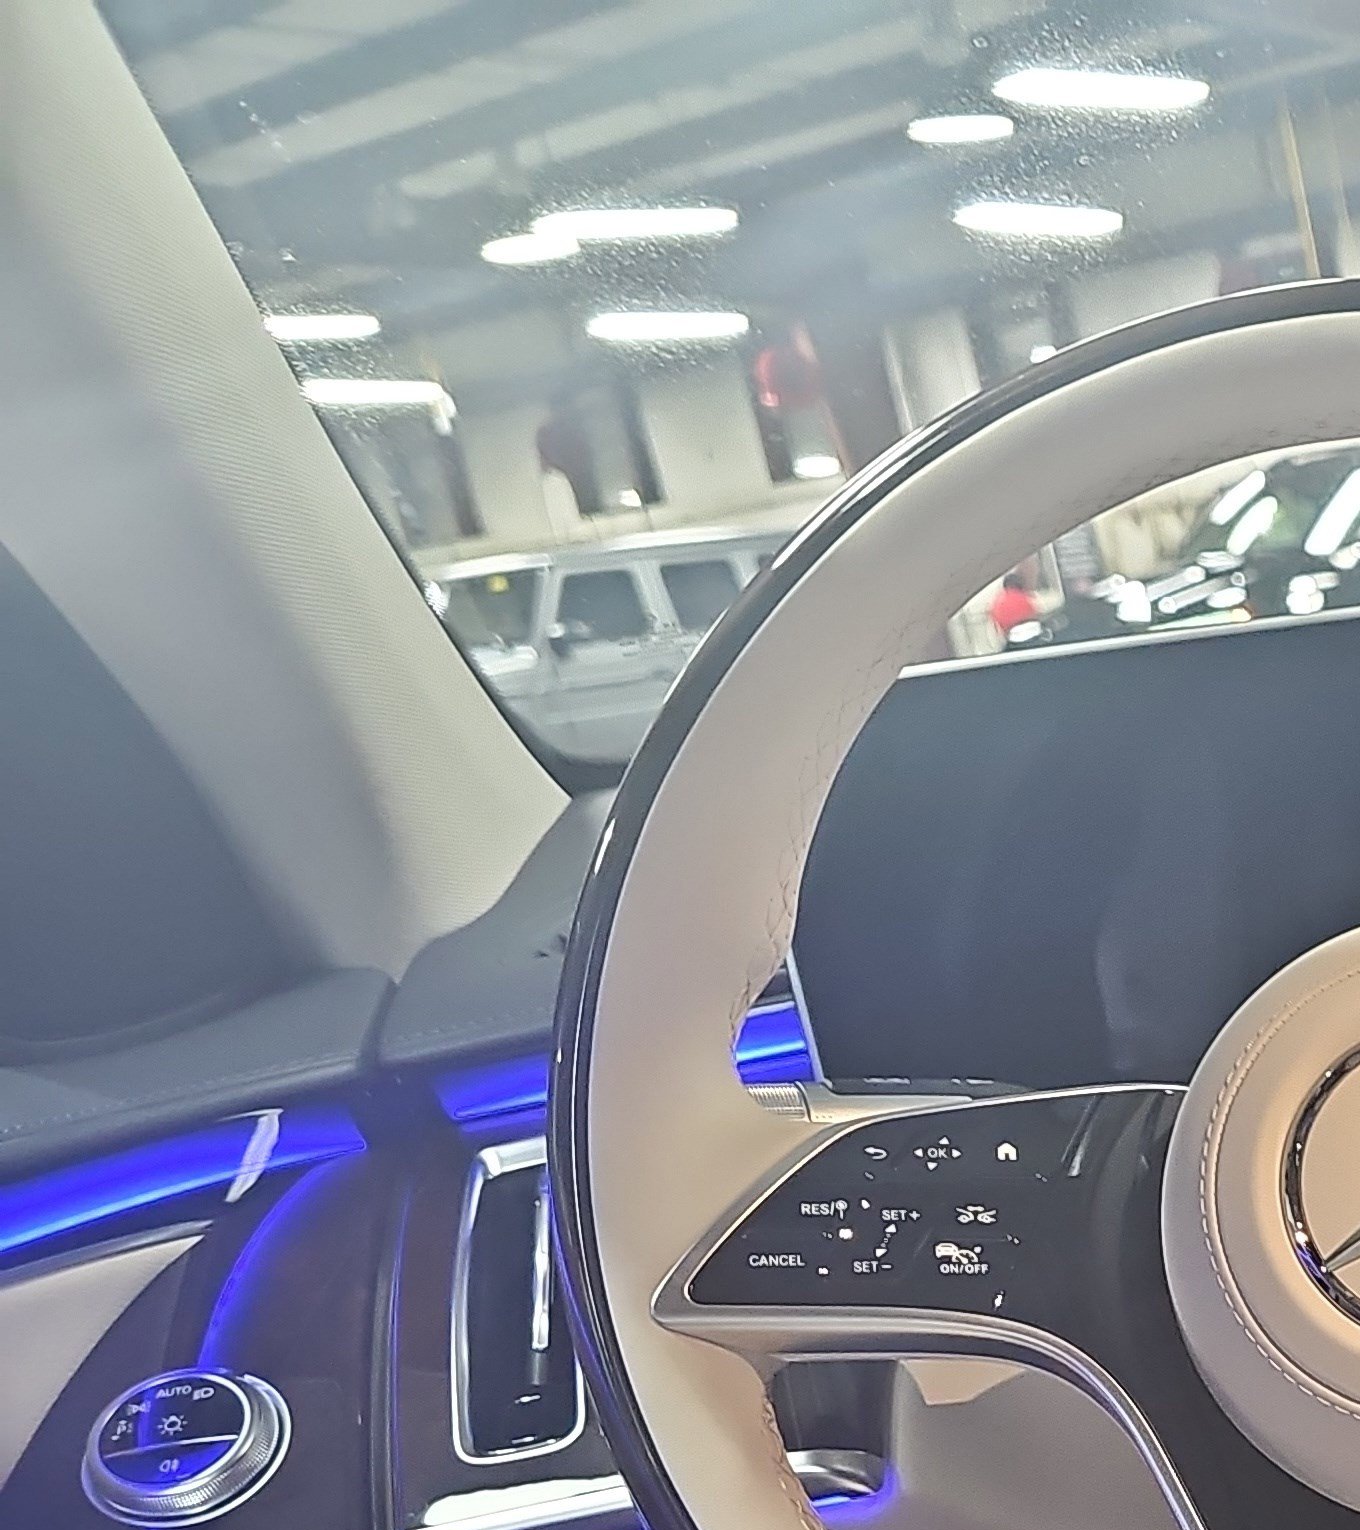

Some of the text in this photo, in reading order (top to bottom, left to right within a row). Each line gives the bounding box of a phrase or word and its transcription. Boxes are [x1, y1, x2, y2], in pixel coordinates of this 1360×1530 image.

[927, 1147, 948, 1159] OK
[748, 1253, 806, 1268] CANCEL
[939, 1263, 989, 1275] ON/OFF
[155, 1385, 193, 1400] AUTO
